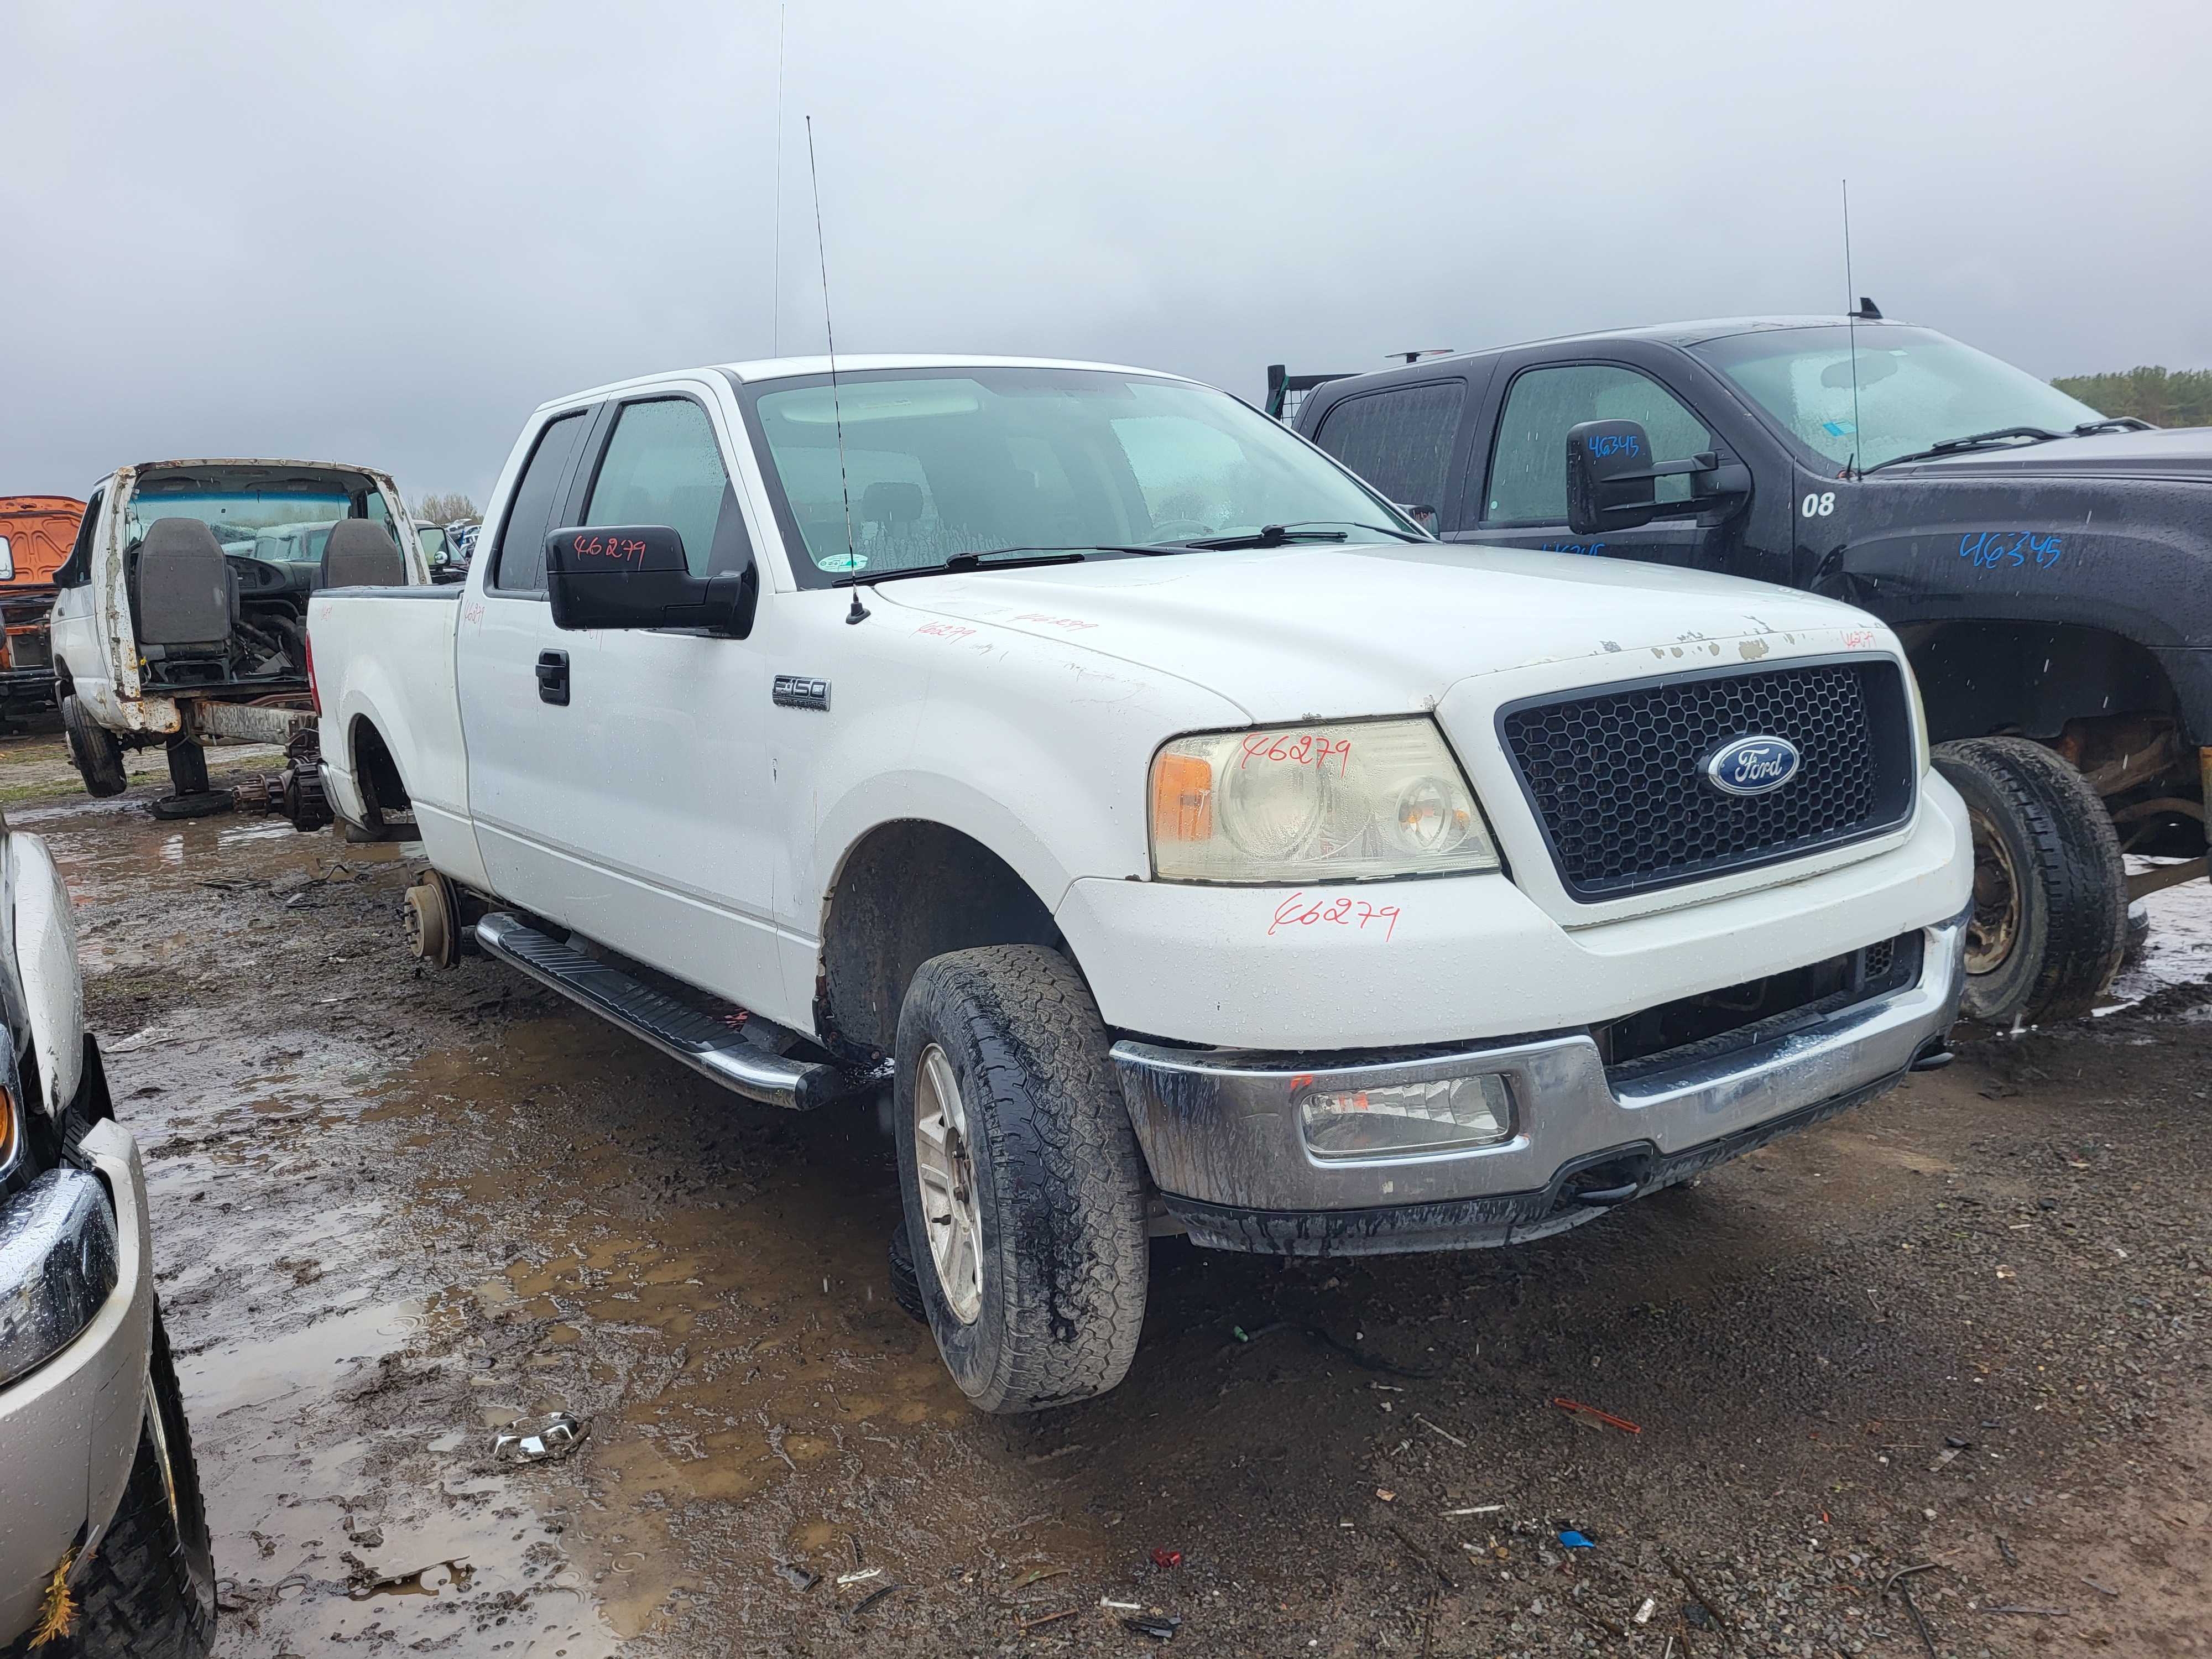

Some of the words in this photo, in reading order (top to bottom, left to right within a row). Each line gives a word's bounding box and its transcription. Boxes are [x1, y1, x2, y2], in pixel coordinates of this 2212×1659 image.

[1589, 436, 1639, 458] 46345
[1802, 492, 1835, 517] 08
[574, 536, 645, 571] 46279
[1960, 531, 2062, 569] 46345
[909, 622, 976, 645] 46279
[774, 678, 826, 698] F-150
[1241, 733, 1351, 778] 46279
[1735, 748, 1782, 782] Ford
[1267, 893, 1400, 942] 46279
